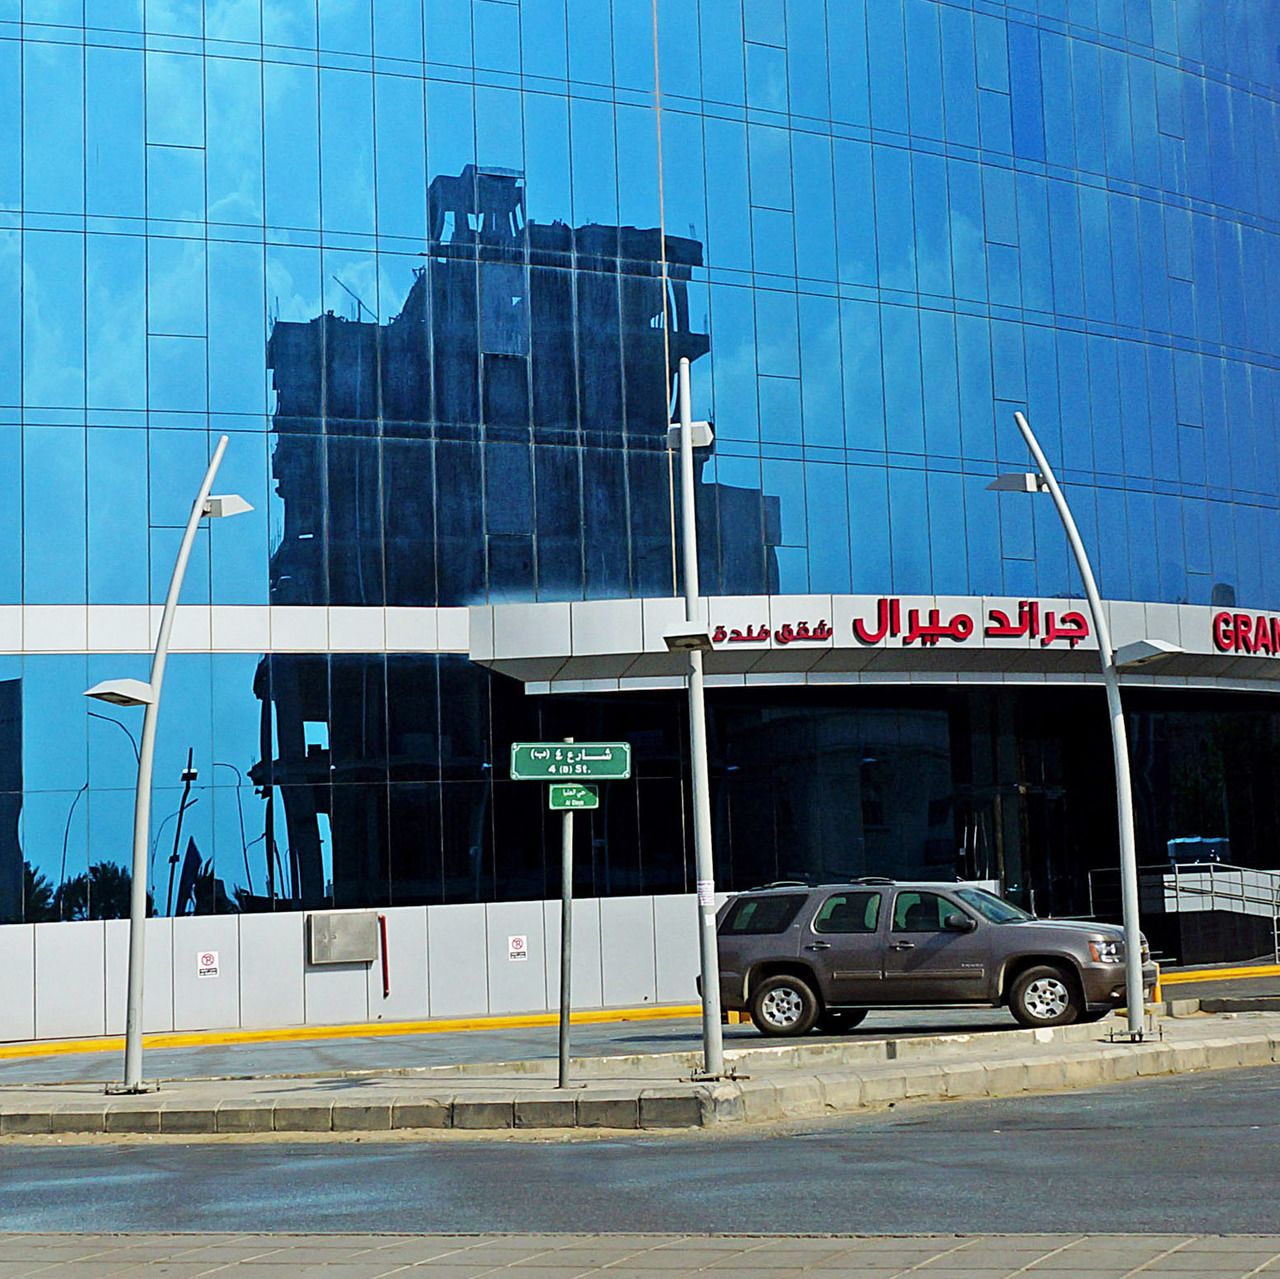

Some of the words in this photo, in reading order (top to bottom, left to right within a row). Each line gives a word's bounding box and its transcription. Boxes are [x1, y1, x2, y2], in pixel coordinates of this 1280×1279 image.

[774, 620, 833, 645] شقق
[853, 598, 974, 646] ميرال
[984, 600, 1090, 648] جراند
[548, 764, 556, 773] 4
[575, 764, 591, 774] St.
